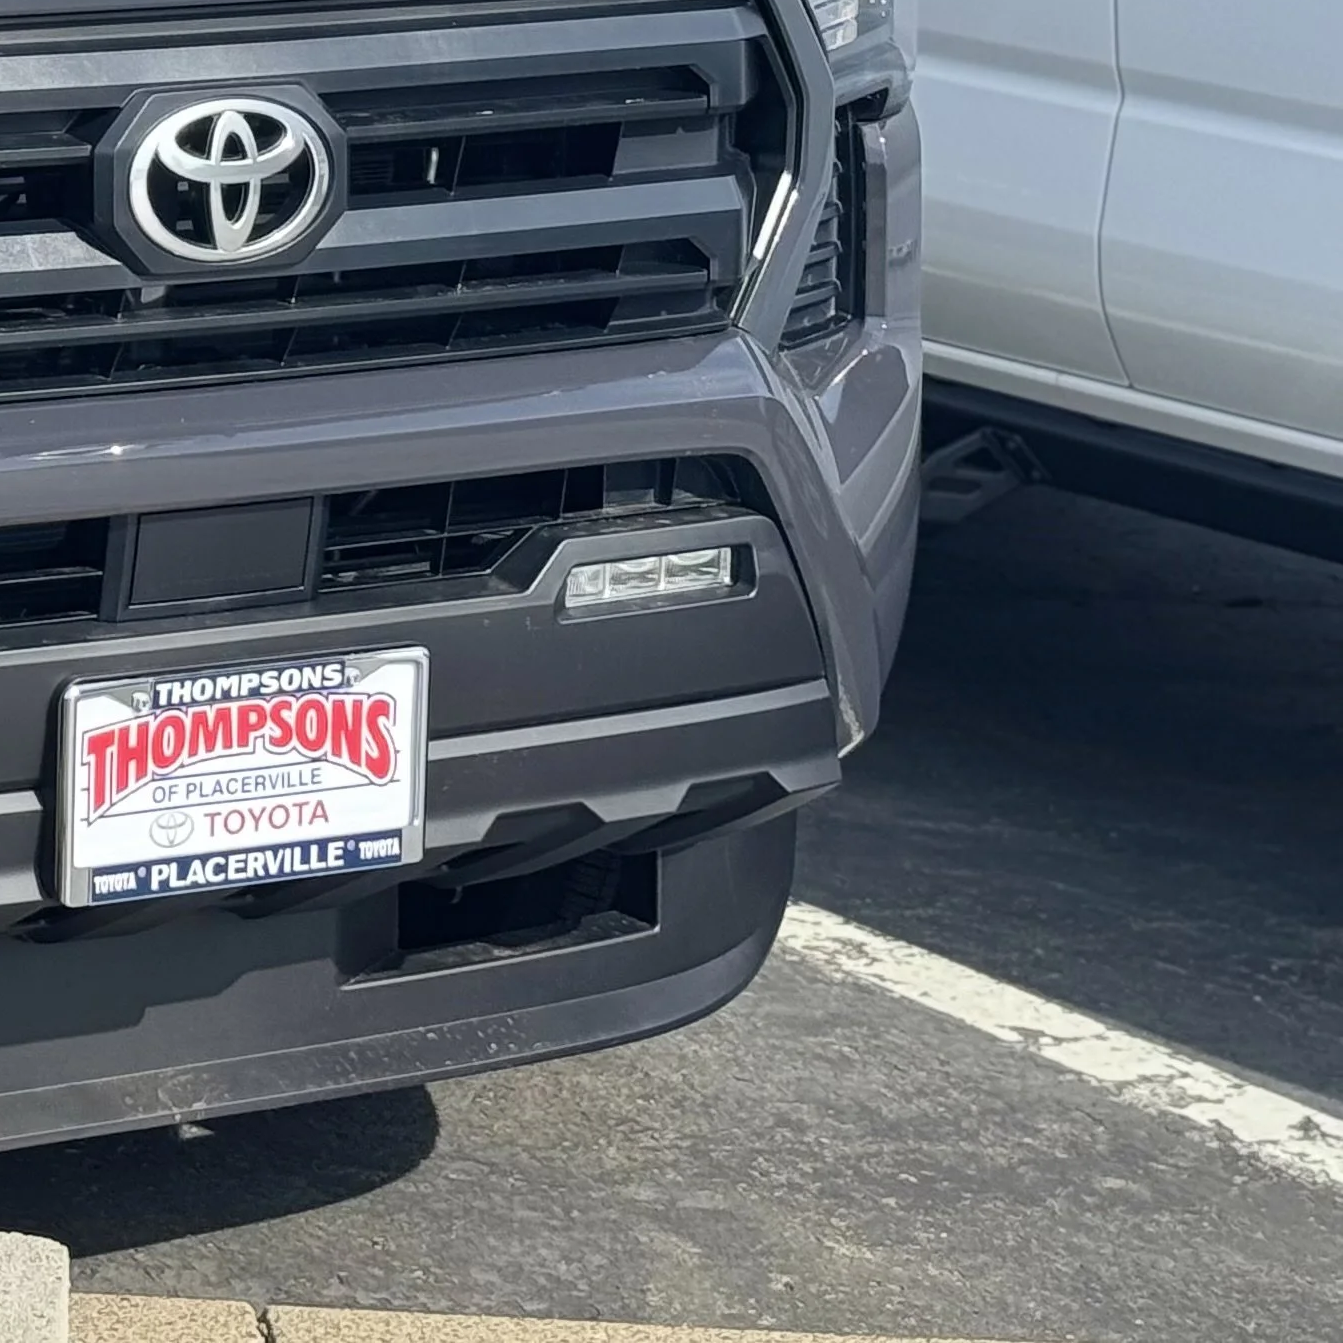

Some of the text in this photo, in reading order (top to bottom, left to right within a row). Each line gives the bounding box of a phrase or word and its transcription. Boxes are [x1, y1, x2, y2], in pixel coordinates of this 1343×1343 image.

[155, 663, 343, 705] THOMPSONS
[86, 697, 395, 815] THOMPSONS
[152, 767, 323, 805] OF PLACERVILLE
[203, 799, 330, 838] TOYOTA
[93, 836, 401, 895] TOYOTA PLACERVILLE TOYOTA
